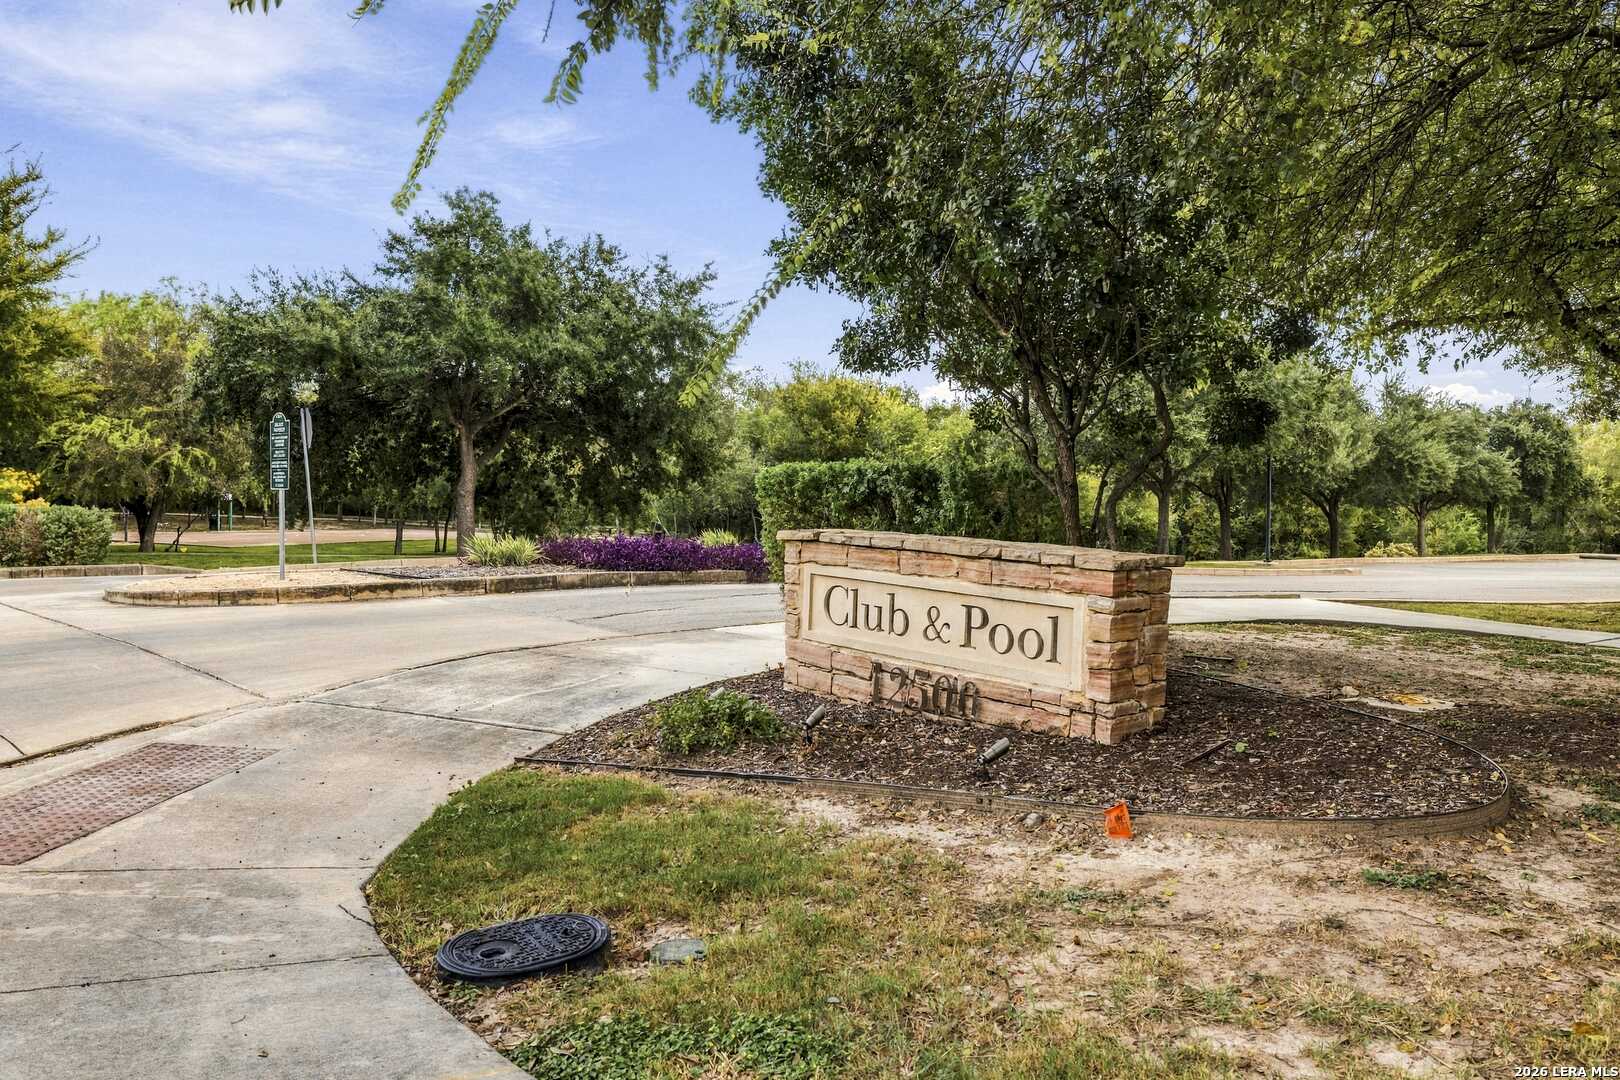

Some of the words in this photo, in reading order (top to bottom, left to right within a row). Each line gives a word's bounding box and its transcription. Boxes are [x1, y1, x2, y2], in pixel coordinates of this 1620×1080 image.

[824, 584, 910, 637] Club
[922, 604, 951, 645] &
[960, 604, 1062, 665] Pool
[871, 662, 979, 719] 12500
